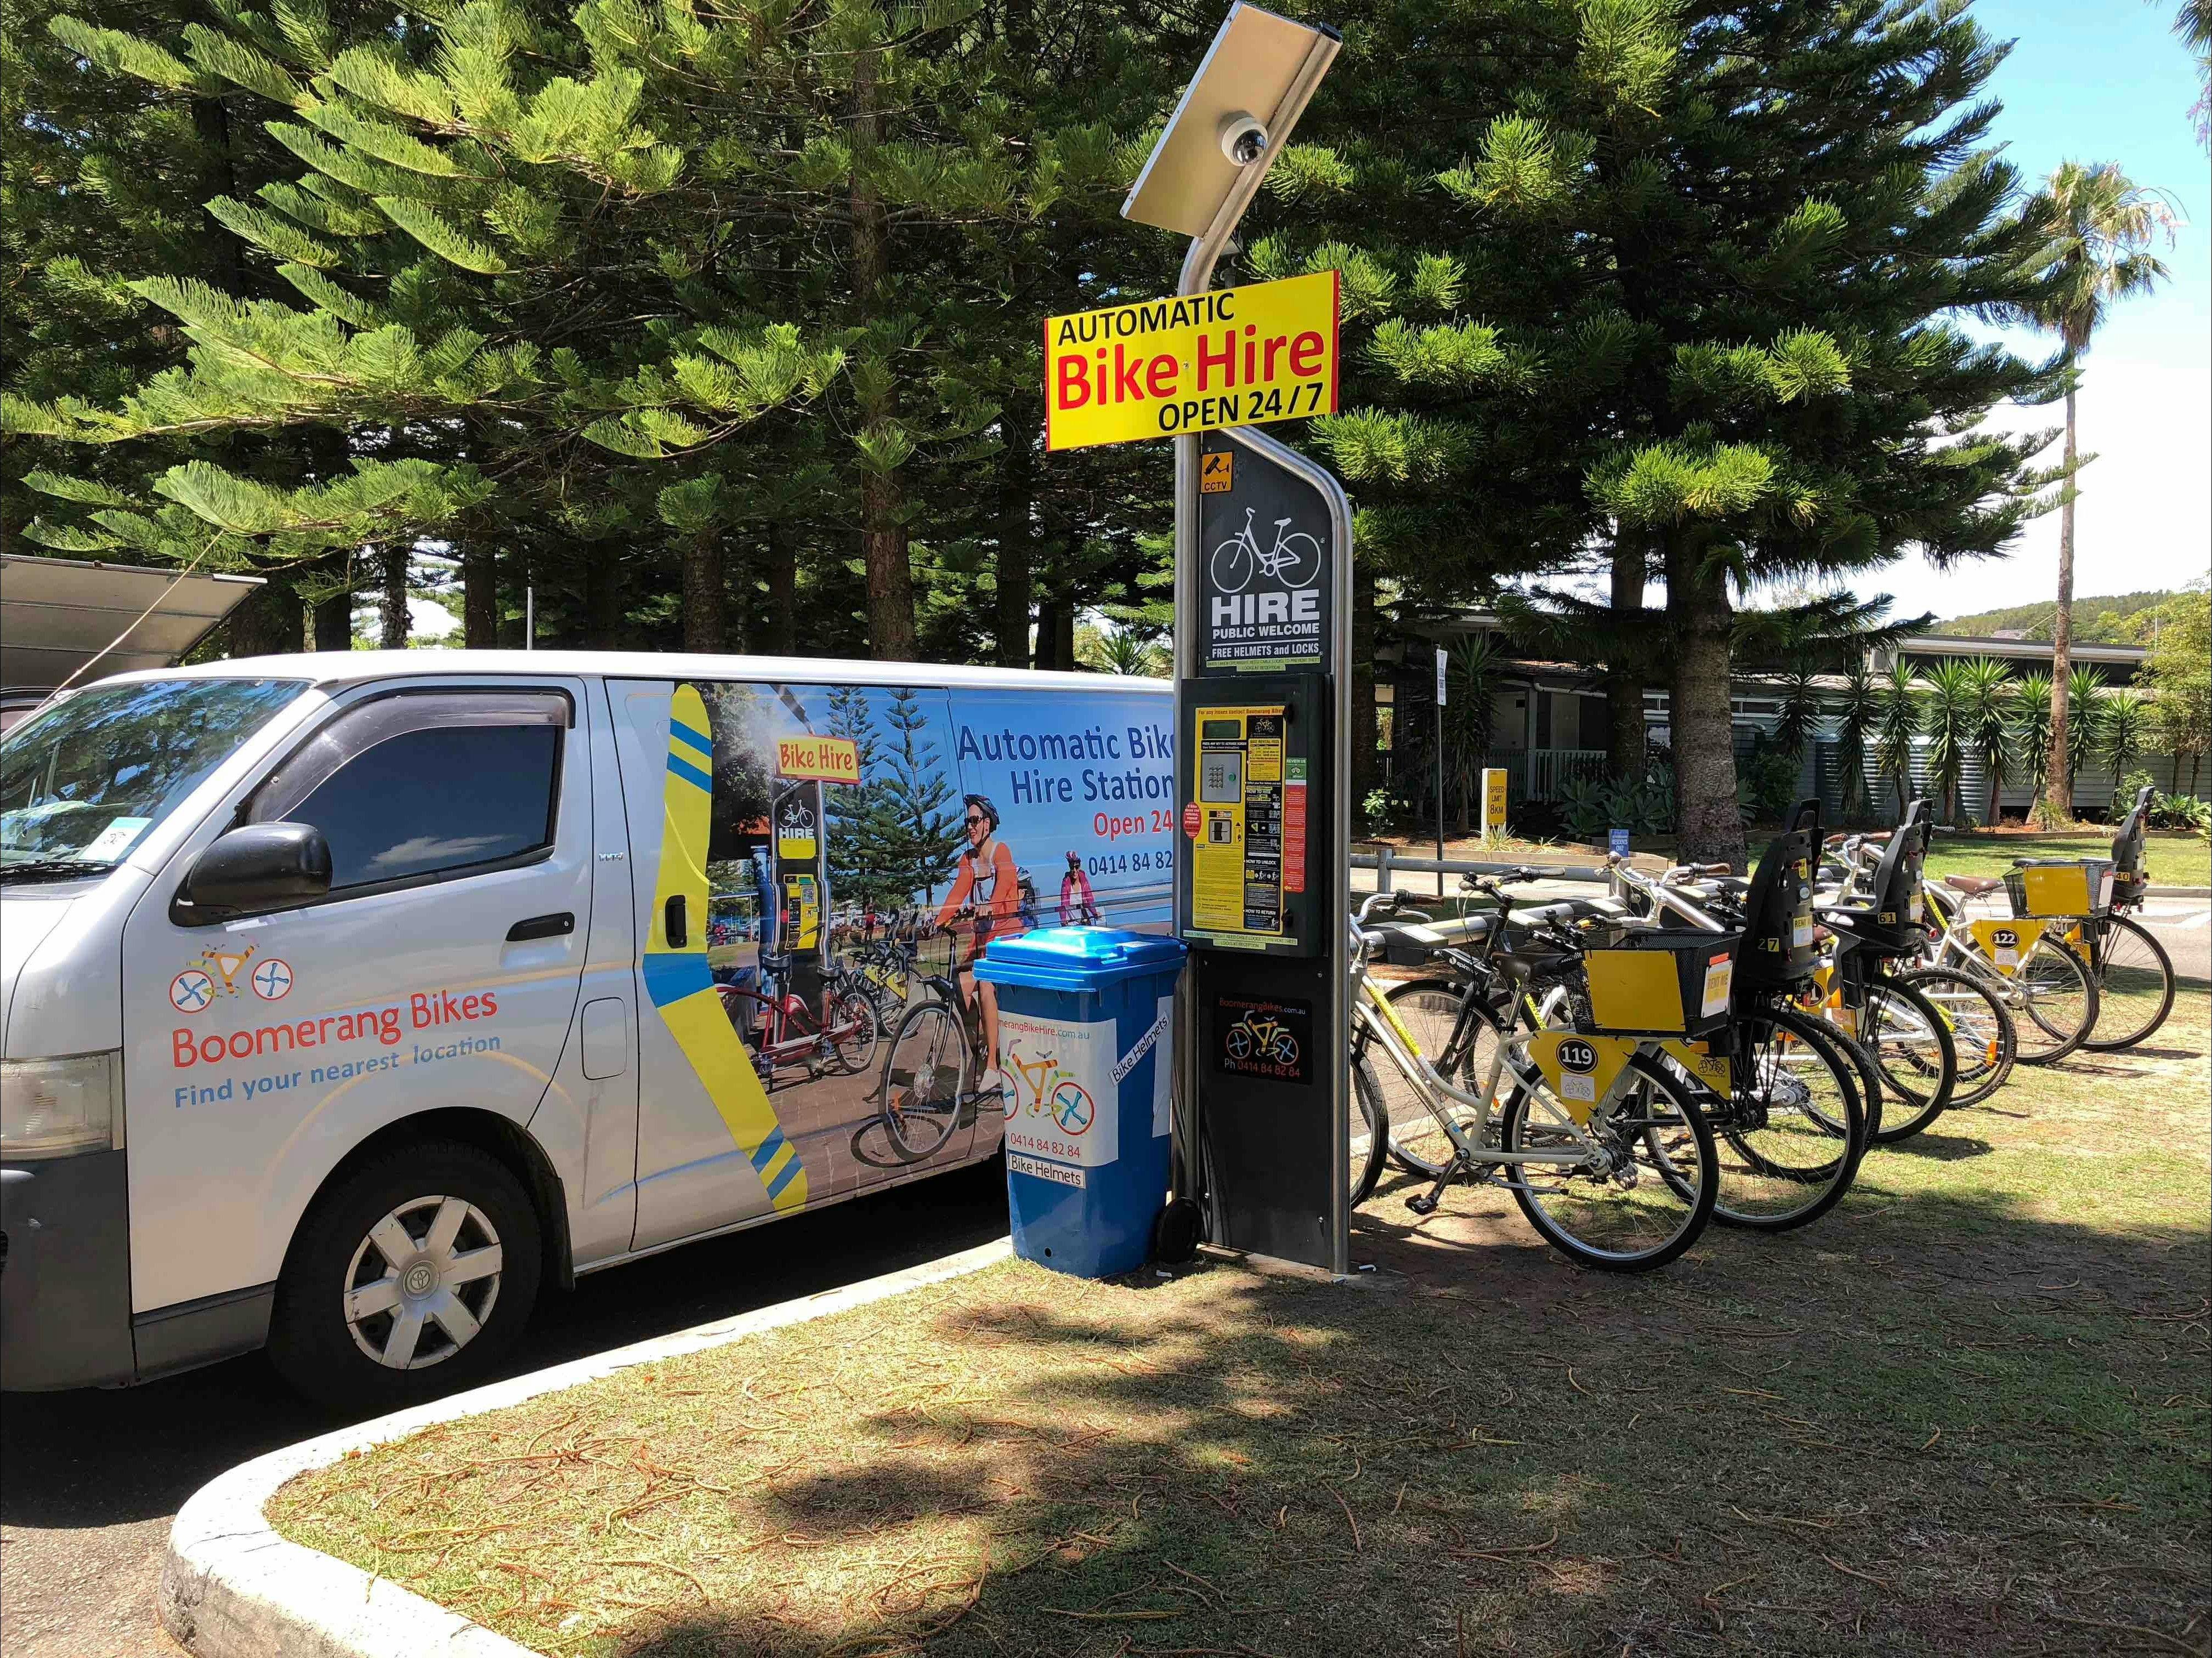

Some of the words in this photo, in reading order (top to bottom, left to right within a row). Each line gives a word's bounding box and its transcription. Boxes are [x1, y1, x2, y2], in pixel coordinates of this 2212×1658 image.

[1057, 292, 1235, 346] AUTOMATIC
[1058, 343, 1178, 410] Bike
[1197, 324, 1325, 391] Hire
[1158, 394, 1238, 431] OPEN
[1204, 481, 1227, 491] CCTV
[1211, 589, 1320, 626] HIRE
[1212, 626, 1255, 639] PUBLIC
[1258, 622, 1320, 636] WELCOME
[1212, 647, 1232, 658] FREE
[1234, 645, 1272, 657] HELMETS
[1274, 644, 1289, 655] and
[1292, 643, 1319, 654] LOCKS
[958, 725, 1121, 762] Automatic
[1127, 724, 1173, 759] Bik
[780, 743, 815, 769] Bike
[819, 744, 853, 771] Hire
[1010, 769, 1074, 804] Hire
[1083, 767, 1173, 802] Station
[1490, 804, 1503, 815] 8KM
[779, 828, 815, 839] HIRE
[1094, 812, 1145, 841] Open
[1150, 809, 1173, 833] 24
[1088, 854, 1127, 877] 0414
[1132, 853, 1150, 872] 84
[1155, 850, 1173, 870] 82
[1879, 913, 1895, 923] 61
[1759, 938, 1779, 952] 27
[1994, 933, 2016, 944] 122
[172, 1006, 401, 1069] Boomerang
[409, 989, 499, 1030] Bikes
[1111, 1057, 1135, 1083] Bike
[1132, 1015, 1169, 1059] Helmets
[1562, 1046, 1593, 1065] 119
[174, 1077, 234, 1108] Find
[241, 1070, 301, 1100] your
[310, 1052, 401, 1085] nearest
[412, 1035, 502, 1065] location
[1224, 1058, 1235, 1069] Ph
[1237, 1060, 1258, 1072] 0414
[1261, 1063, 1272, 1074] 84
[1275, 1065, 1286, 1076] 82
[1289, 1068, 1301, 1077] 84
[1011, 1133, 1034, 1149] 0414
[1036, 1139, 1050, 1152] 84
[1052, 1142, 1064, 1155] 82
[1067, 1145, 1080, 1159] 84
[1011, 1155, 1033, 1174] Bike
[1035, 1161, 1081, 1185] Helmets
